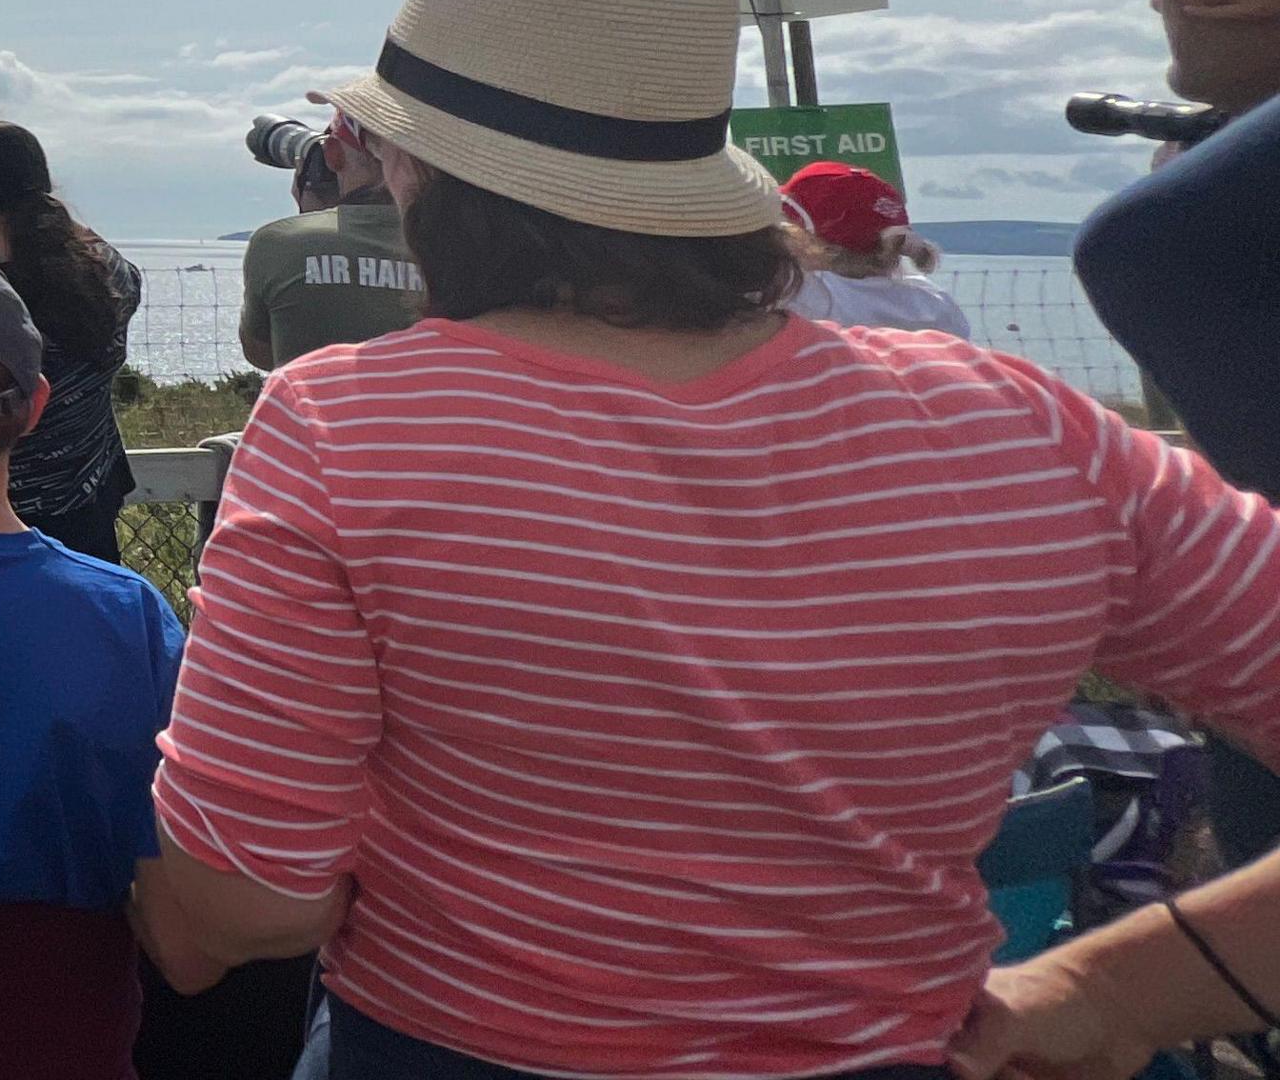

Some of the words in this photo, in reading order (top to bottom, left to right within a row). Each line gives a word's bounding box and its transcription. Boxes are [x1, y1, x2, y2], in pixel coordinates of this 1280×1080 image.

[745, 133, 826, 157] FIRST
[837, 132, 886, 155] AID
[305, 254, 351, 285] AIR
